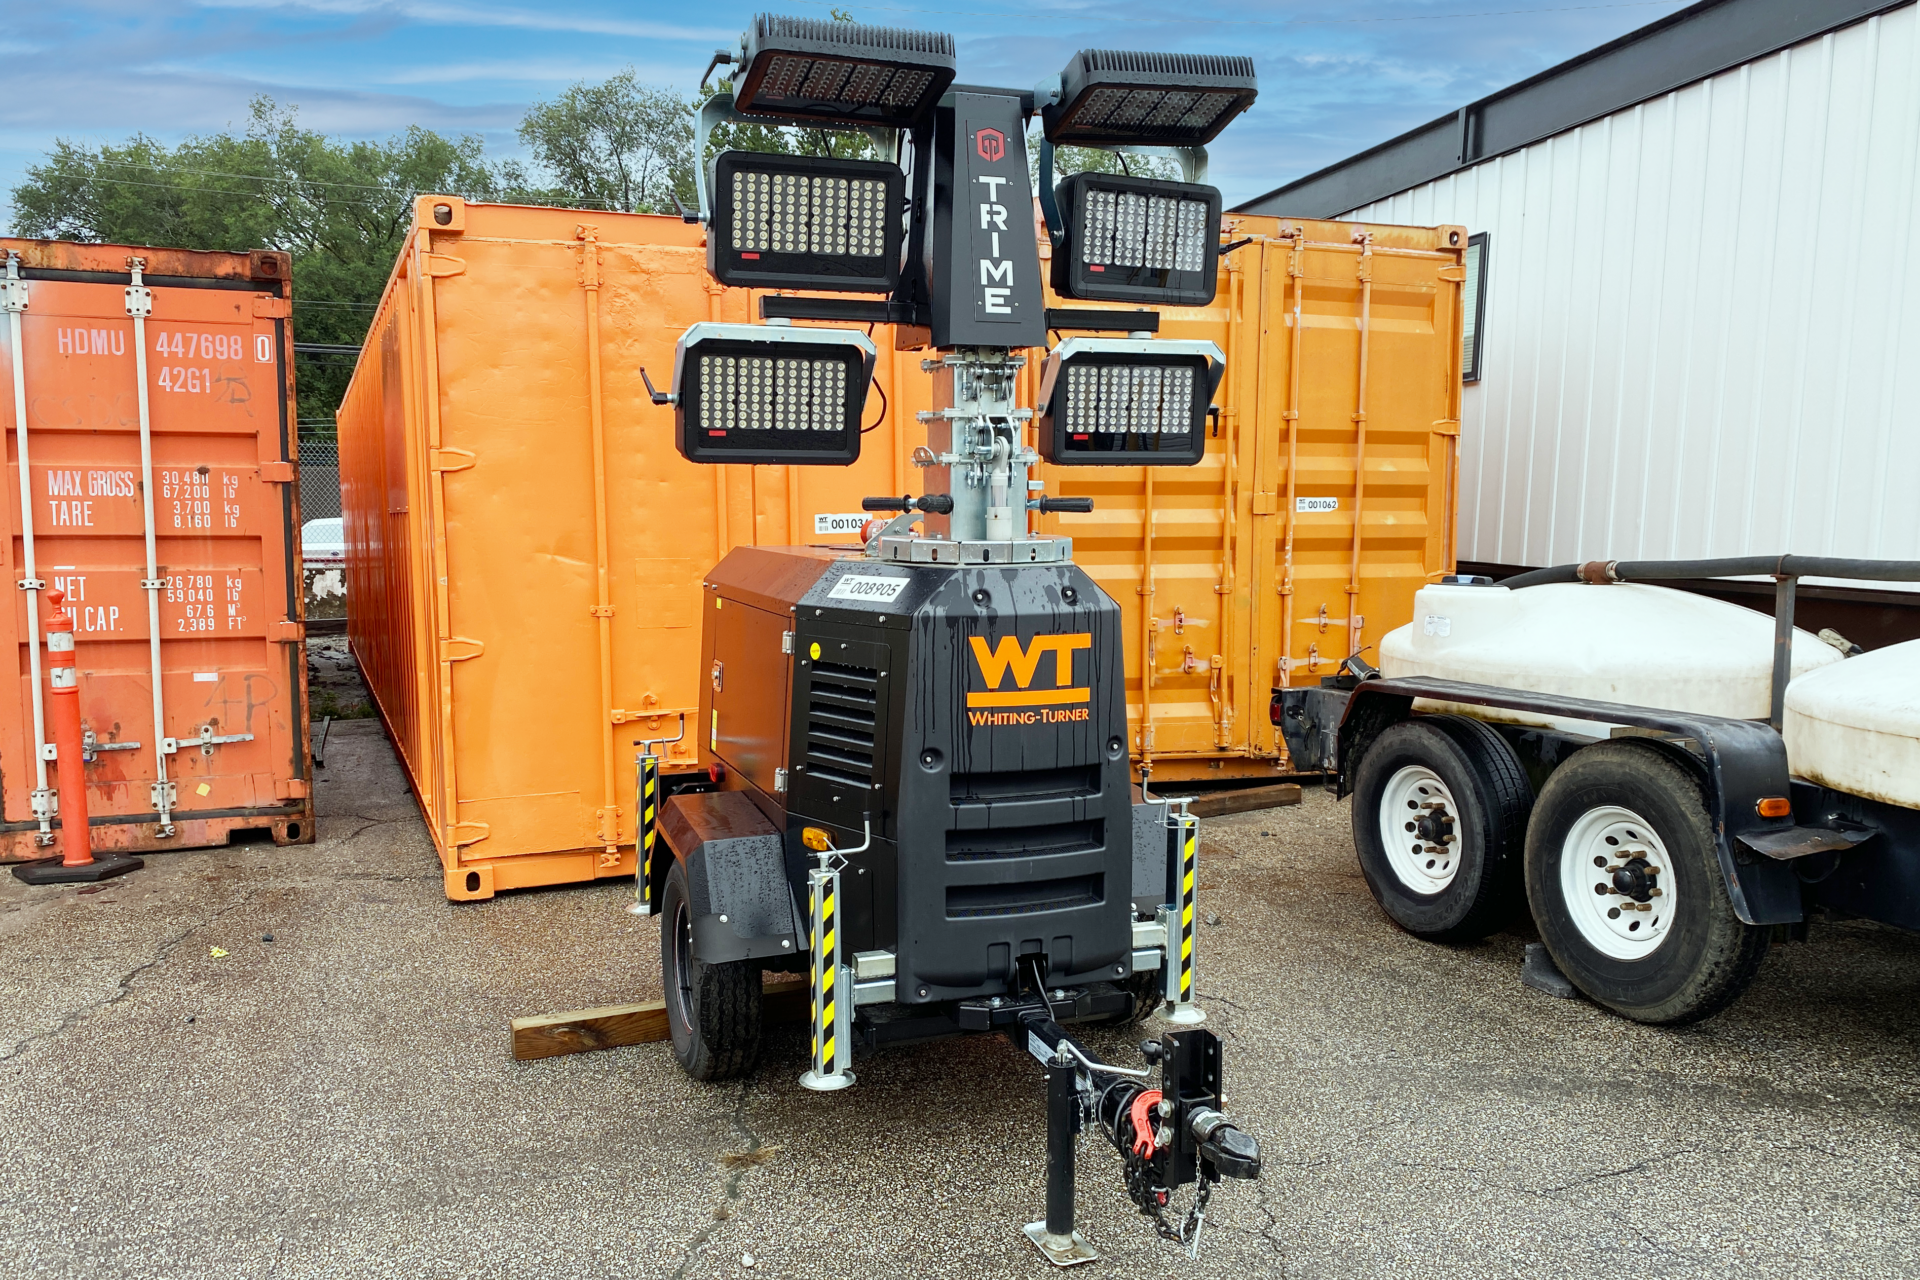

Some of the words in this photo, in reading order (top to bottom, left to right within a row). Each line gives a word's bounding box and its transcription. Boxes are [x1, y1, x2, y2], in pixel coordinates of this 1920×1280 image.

[978, 175, 1014, 314] TRIME
[58, 328, 125, 356] HDMU
[155, 332, 243, 360] 447698
[158, 366, 212, 393] 42G1
[47, 470, 82, 496] MAX
[88, 471, 134, 497] GROSS
[162, 471, 209, 485] 30,480
[223, 472, 239, 488] kg
[163, 485, 210, 500] 67,200
[224, 485, 236, 499] lb
[49, 501, 94, 527] TARE
[173, 501, 211, 515] 3,700
[224, 501, 240, 517] kg
[1308, 500, 1337, 509] 001062
[174, 515, 211, 529] 8,160
[225, 515, 237, 528] lb
[831, 518, 868, 530] 00103
[54, 576, 87, 601] NET
[166, 575, 213, 590] 26,780
[226, 575, 242, 591] kg
[167, 589, 213, 603] 59,040
[227, 589, 239, 602] lb
[849, 581, 901, 597] 008905
[61, 606, 124, 632] U.CAP.
[186, 604, 214, 618] 67.6
[178, 617, 215, 632] 2,389
[968, 632, 1092, 689] WT
